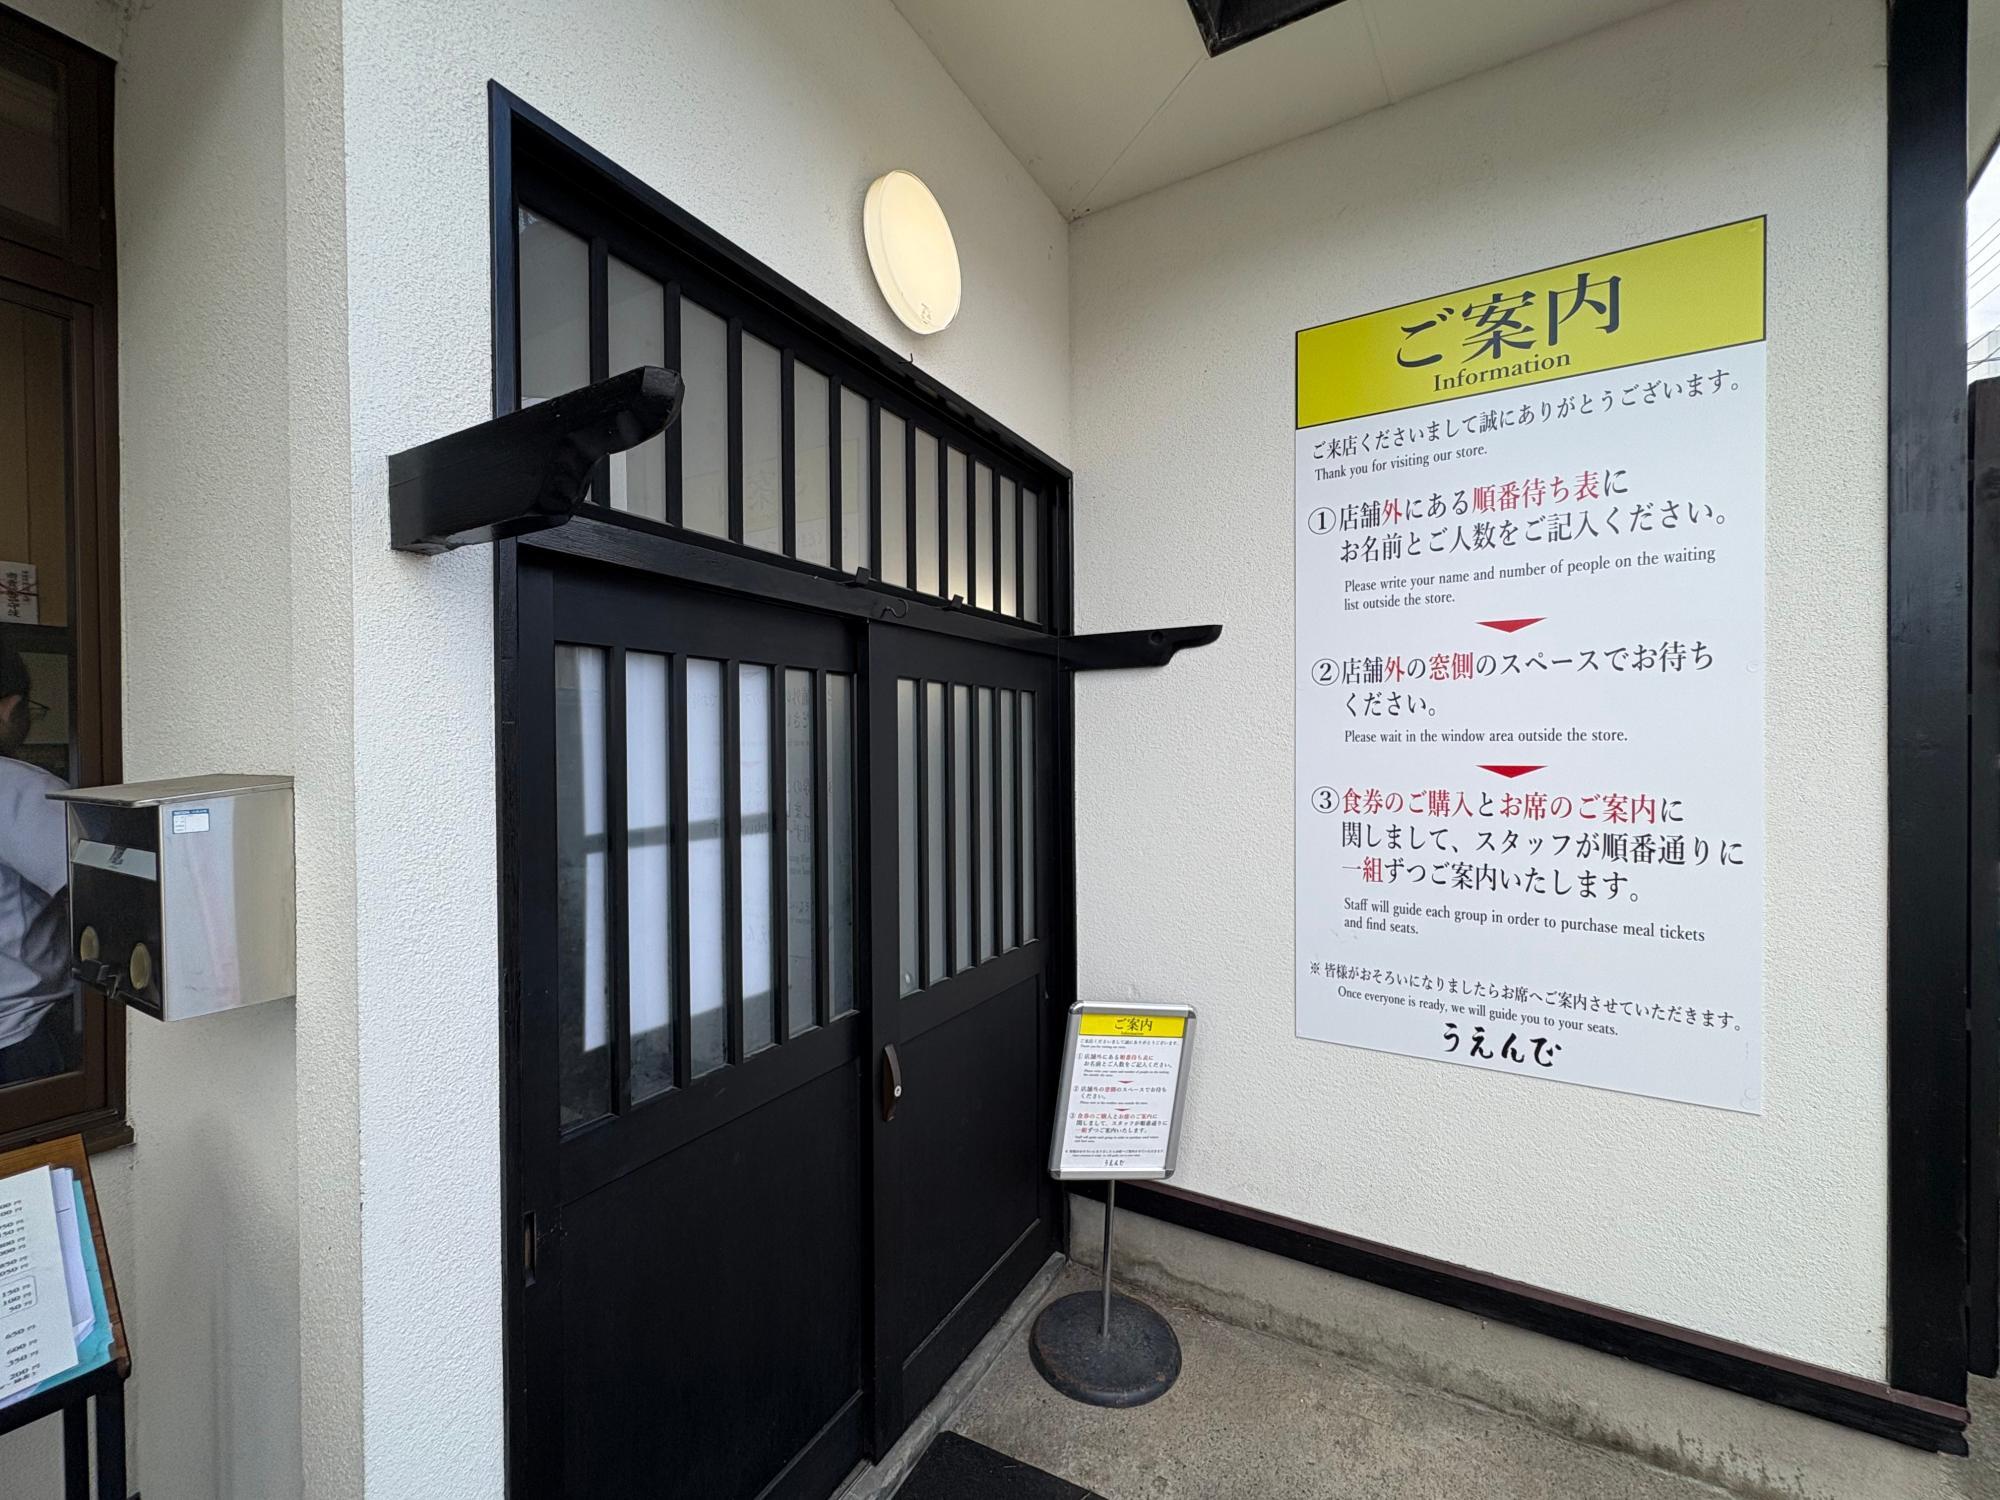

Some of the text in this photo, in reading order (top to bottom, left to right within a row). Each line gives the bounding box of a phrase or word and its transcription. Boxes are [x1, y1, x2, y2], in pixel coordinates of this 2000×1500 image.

[1395, 271, 1623, 369] ご案内
[1432, 352, 1572, 393] Information
[1312, 368, 1739, 460] ご来店くださいまして誠にありがとうございます。
[1313, 445, 1488, 482] Thank you for visiting our store.
[1339, 499, 1726, 564] お名前とご人数をご記入ください。
[1344, 545, 1717, 593] Please write your name and number of people on the waiting
[1343, 591, 1456, 612] list outside the store.
[1345, 690, 1436, 718] ください。
[1344, 726, 1629, 744] Please wait in the window area outside the store.
[1341, 820, 1745, 867] 関しまして、スタッフが順番通りに
[1341, 855, 1639, 903] 一組ずつご案内いたします。
[1343, 896, 1706, 943] Staff will guide each group in order to purchase meal tickets
[1343, 915, 1420, 935] and find seats.
[1114, 1017, 1153, 1031] ご案内
[1336, 984, 1619, 1037] Once everyone is ready, we will guide you to your seats.
[1442, 1021, 1563, 1069] うえんで
